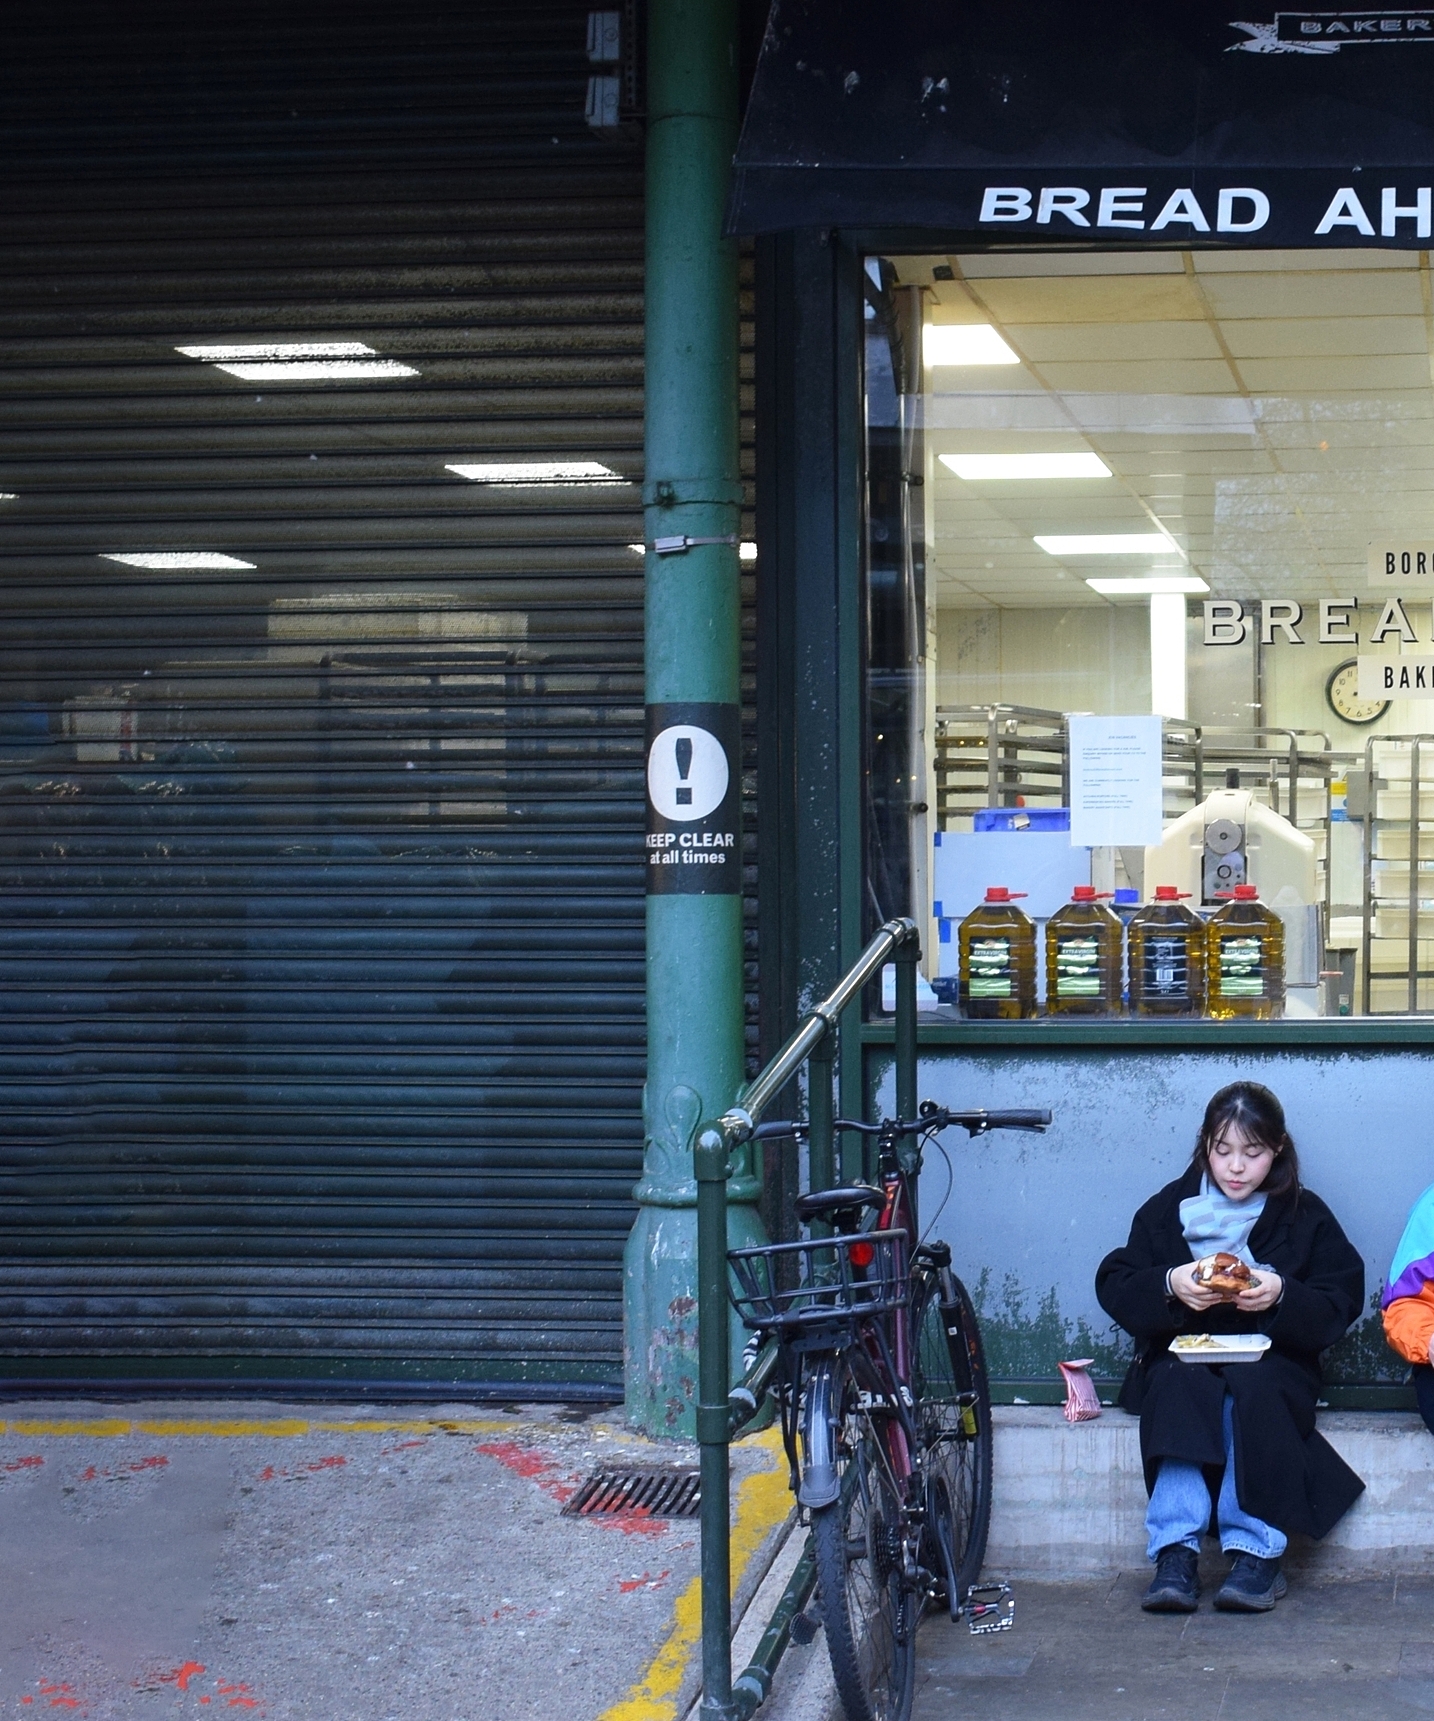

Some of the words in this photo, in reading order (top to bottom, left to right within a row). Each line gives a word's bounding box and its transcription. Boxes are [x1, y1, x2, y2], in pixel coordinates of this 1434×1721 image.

[978, 187, 1271, 232] BREAD
[646, 833, 676, 848] KEEP
[679, 832, 735, 847] CLEAR
[650, 851, 661, 864] at
[662, 850, 679, 864] all
[681, 850, 726, 864] times
